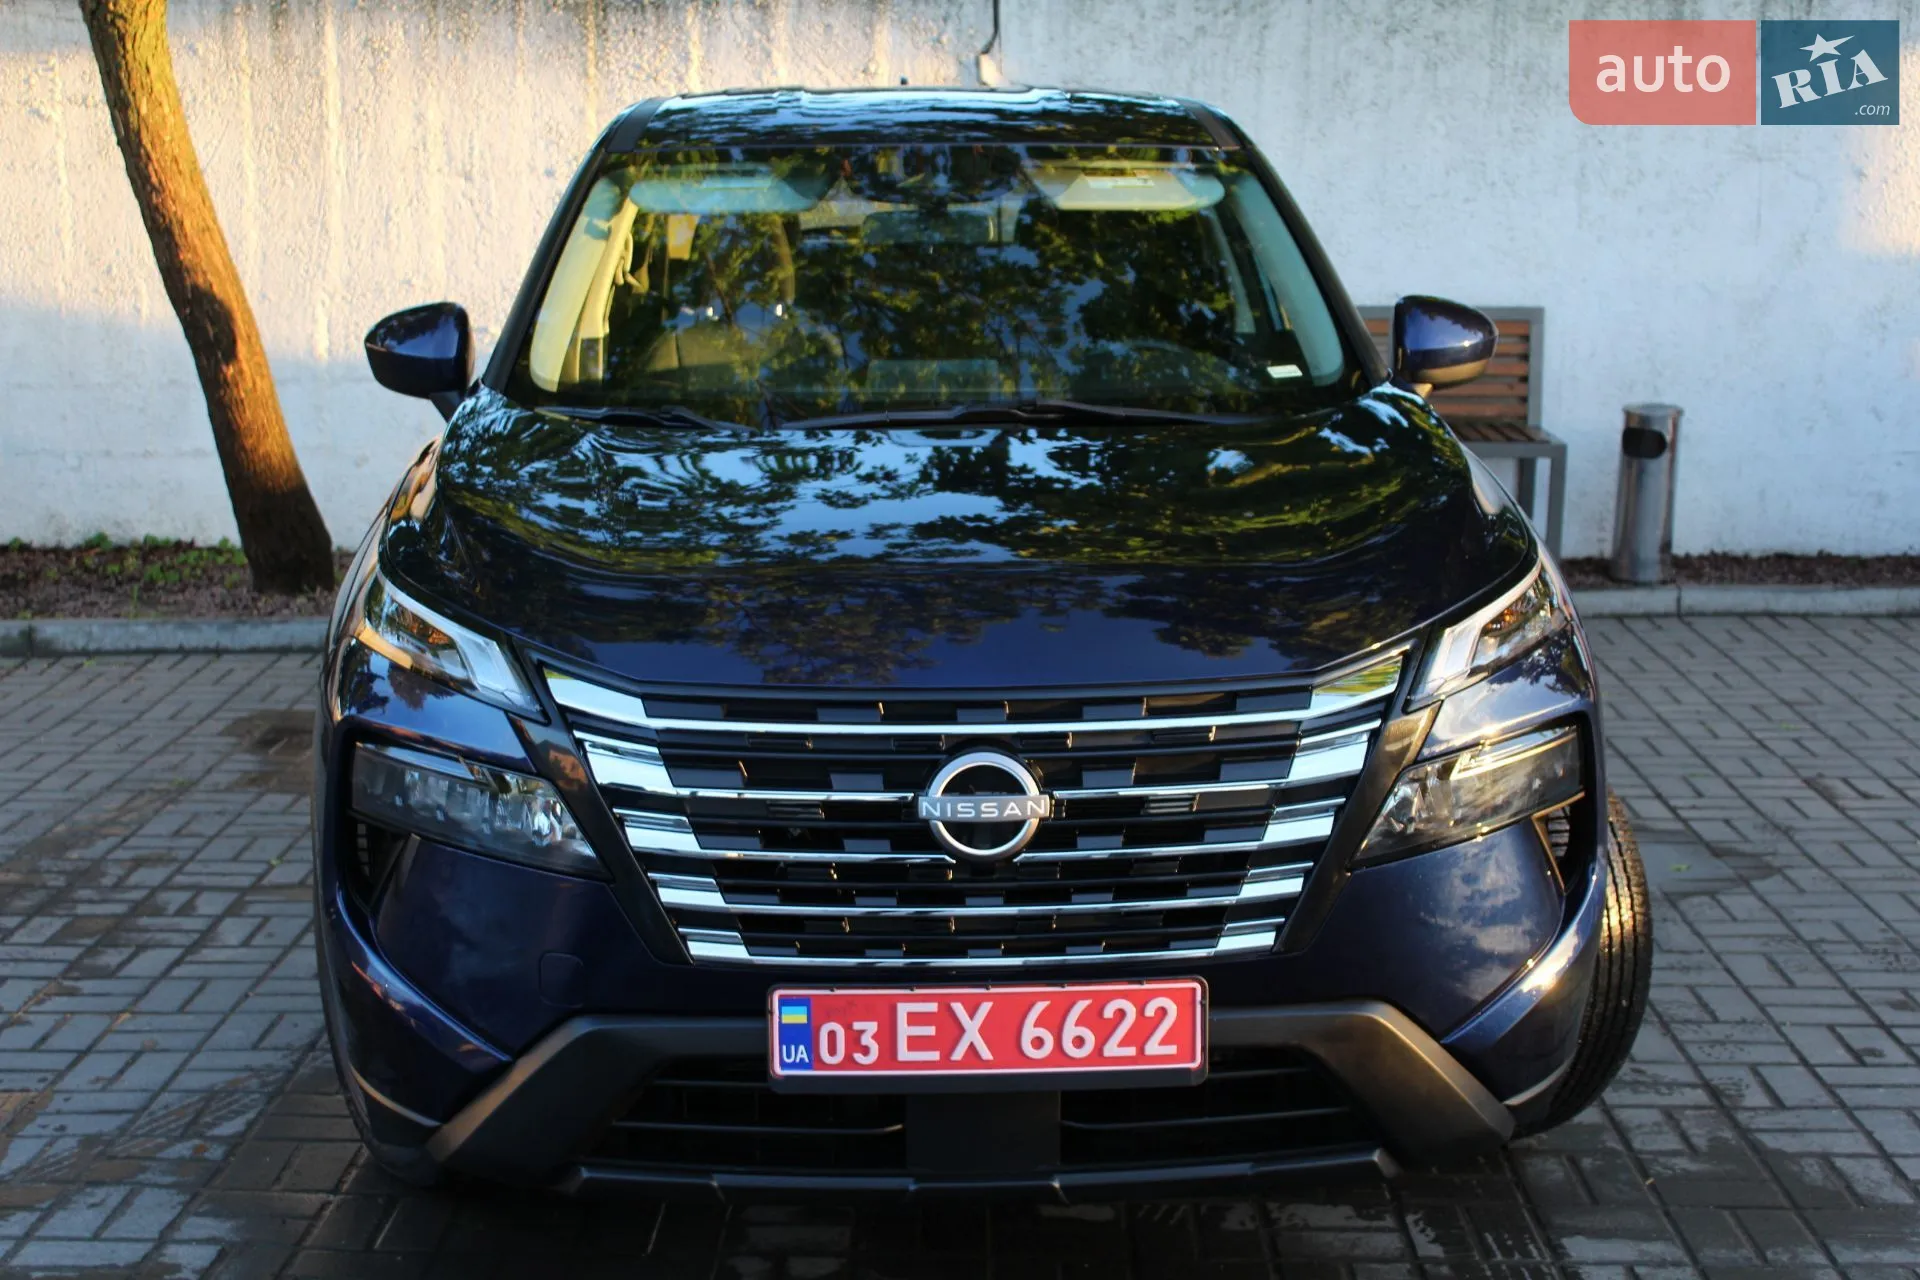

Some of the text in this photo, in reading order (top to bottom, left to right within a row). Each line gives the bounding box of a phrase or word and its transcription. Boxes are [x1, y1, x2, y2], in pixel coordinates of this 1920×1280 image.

[921, 799, 1046, 819] NISSAN
[818, 996, 1178, 1065] 03 EX 6622
[782, 1044, 810, 1063] UA
